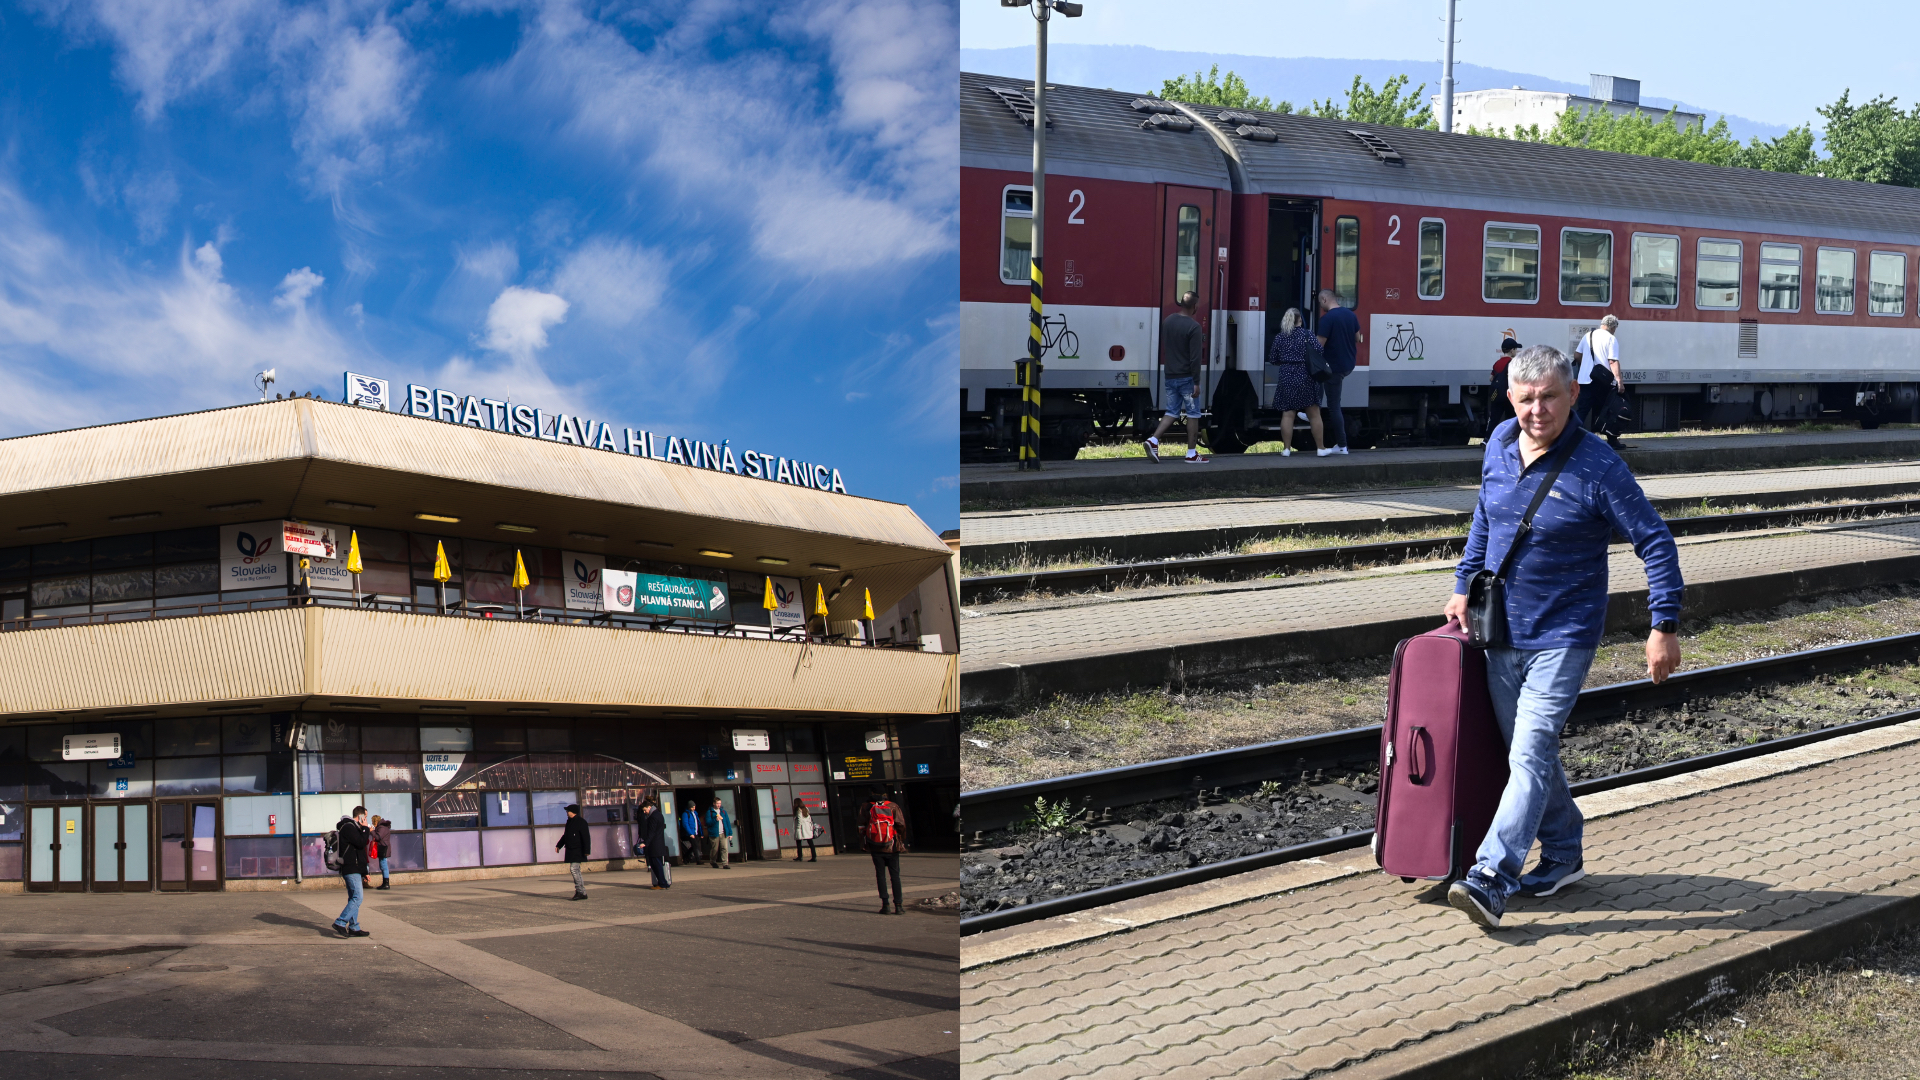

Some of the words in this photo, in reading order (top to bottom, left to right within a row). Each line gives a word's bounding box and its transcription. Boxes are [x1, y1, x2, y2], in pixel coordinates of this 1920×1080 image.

[1068, 189, 1085, 224] 2
[1388, 214, 1401, 245] 2
[407, 383, 618, 452] BRATISLAVA
[624, 428, 739, 474] HLAVNÁ
[741, 449, 847, 494] STANICA
[231, 563, 277, 577] Slovakia
[298, 565, 348, 577] ovensko
[648, 581, 695, 596] REŠTAURÁCIA
[640, 594, 673, 606] HLAVNÁ
[673, 598, 705, 609] STANICA
[424, 764, 458, 772] BRATISLAVU
